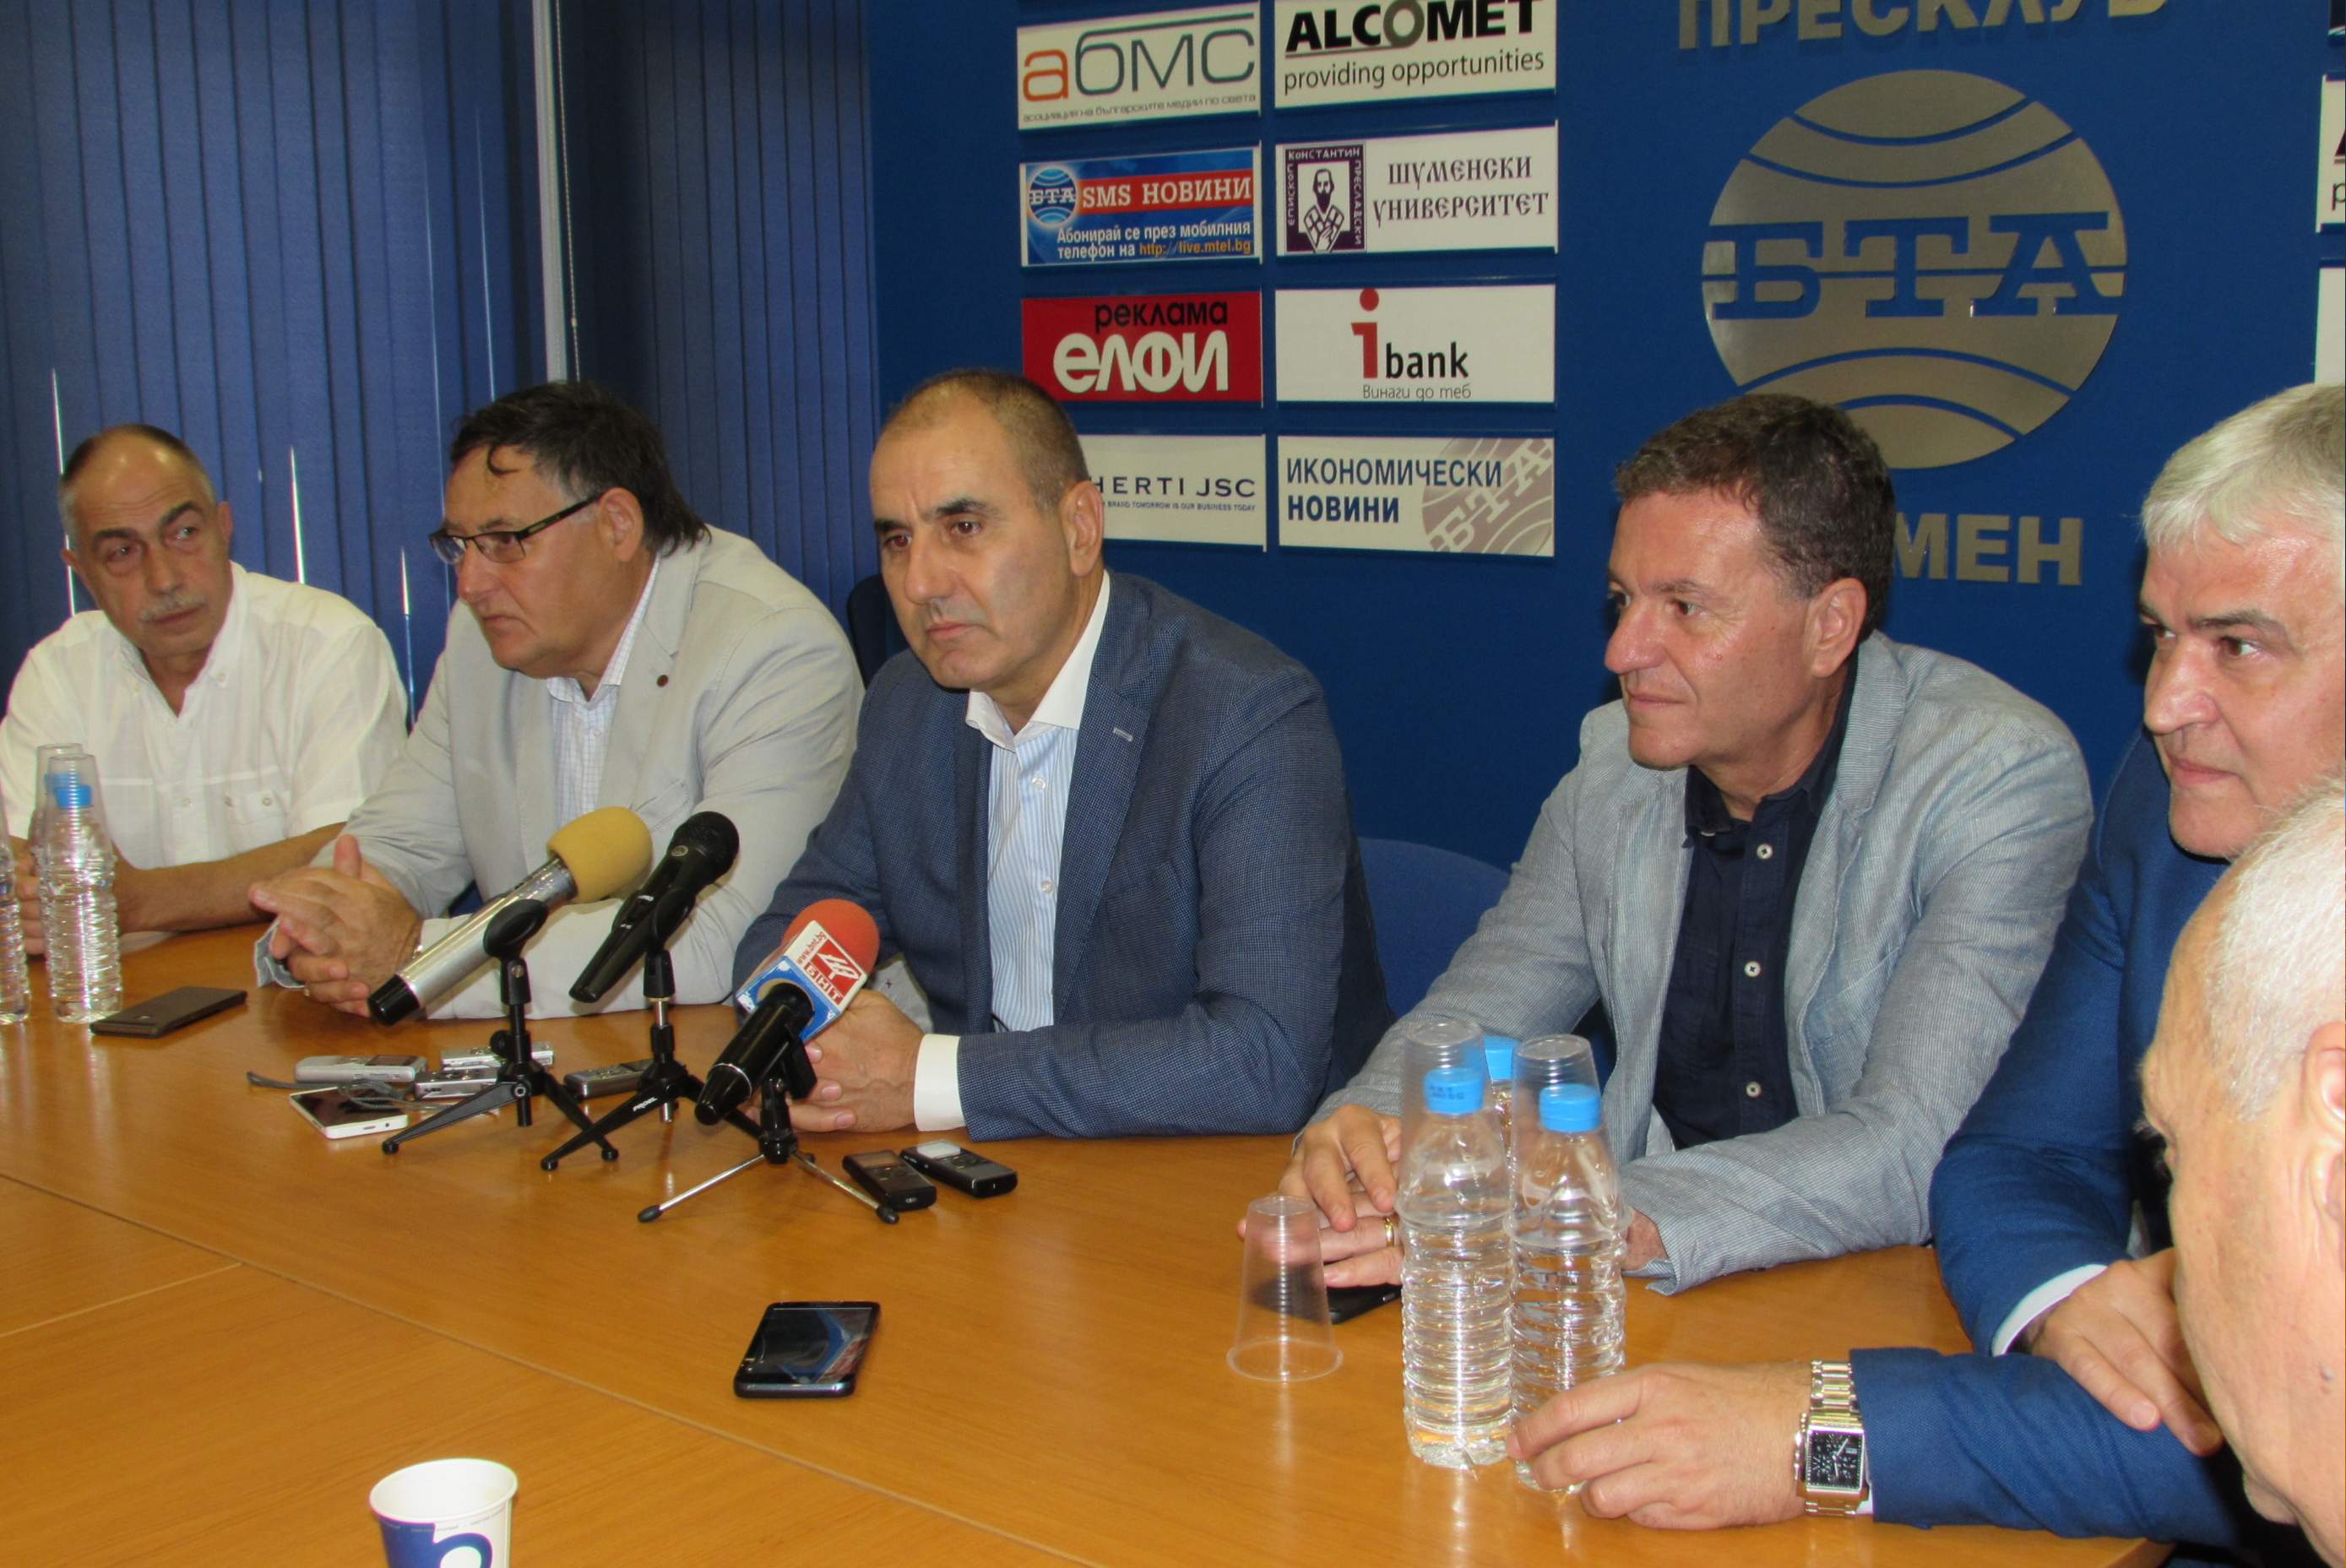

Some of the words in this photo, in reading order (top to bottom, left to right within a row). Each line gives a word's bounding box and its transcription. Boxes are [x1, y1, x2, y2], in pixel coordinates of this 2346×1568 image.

[1285, 0, 1542, 52] ALCOMET
[1284, 62, 1385, 96] providing
[1392, 48, 1545, 85] opportunities
[1080, 108, 1094, 117] на
[1289, 148, 1360, 160] КОНСТАНТИН
[1388, 155, 1533, 191] ШУМЕНСКИ
[1029, 187, 1077, 205] БТА
[1083, 184, 1132, 209] SMS
[1142, 177, 1252, 205] НОВИНИ
[1353, 160, 1363, 245] ПРЕСЛАВСКИ
[1372, 192, 1550, 229] УНИВЕРСИТЕТ
[1057, 224, 1121, 245] Абонирай
[1125, 226, 1140, 241] се
[1144, 224, 1176, 242] през
[1180, 220, 1251, 237] мобилния
[1057, 244, 1115, 262] телефон
[1119, 244, 1135, 257] на
[1708, 211, 2126, 320] БТА
[1094, 301, 1229, 334] реклама
[1362, 384, 1410, 399] Винаги
[1415, 385, 1434, 403] до
[1439, 383, 1472, 399] теб
[1089, 476, 1185, 496] HERTI
[1196, 478, 1256, 498] JSC
[1287, 458, 1502, 487] ИКОНОМИЧЕСКИ
[1288, 495, 1399, 524] НОВИНИ
[1893, 512, 2082, 586] МЕН
[805, 964, 842, 1001] БНТ
